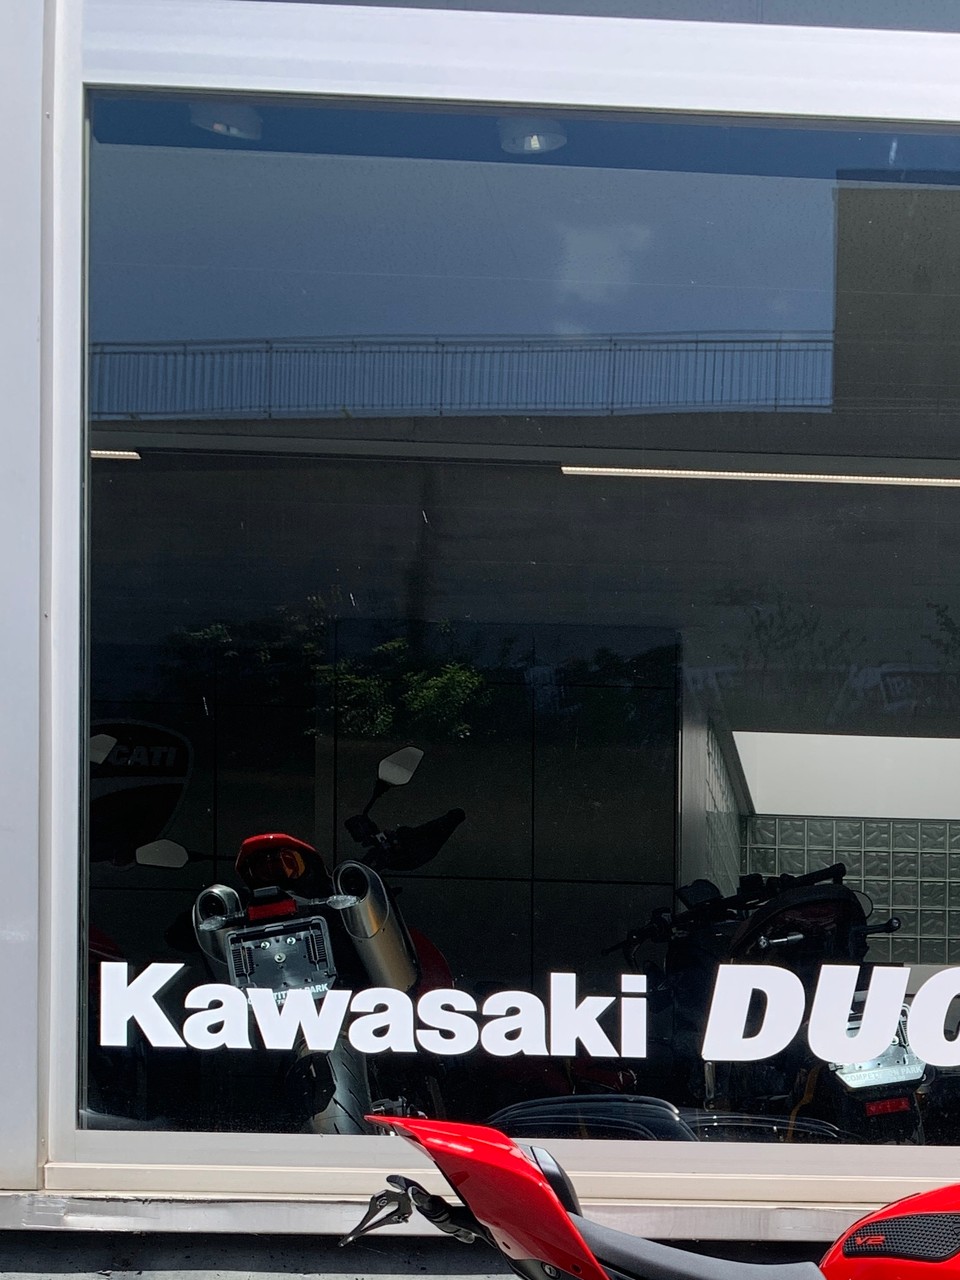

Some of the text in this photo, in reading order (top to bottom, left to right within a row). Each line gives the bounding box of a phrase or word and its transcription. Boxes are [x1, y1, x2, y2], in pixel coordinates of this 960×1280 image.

[107, 744, 177, 769] CATI
[100, 961, 648, 1058] Kawasaki
[856, 1235, 885, 1246] V2
